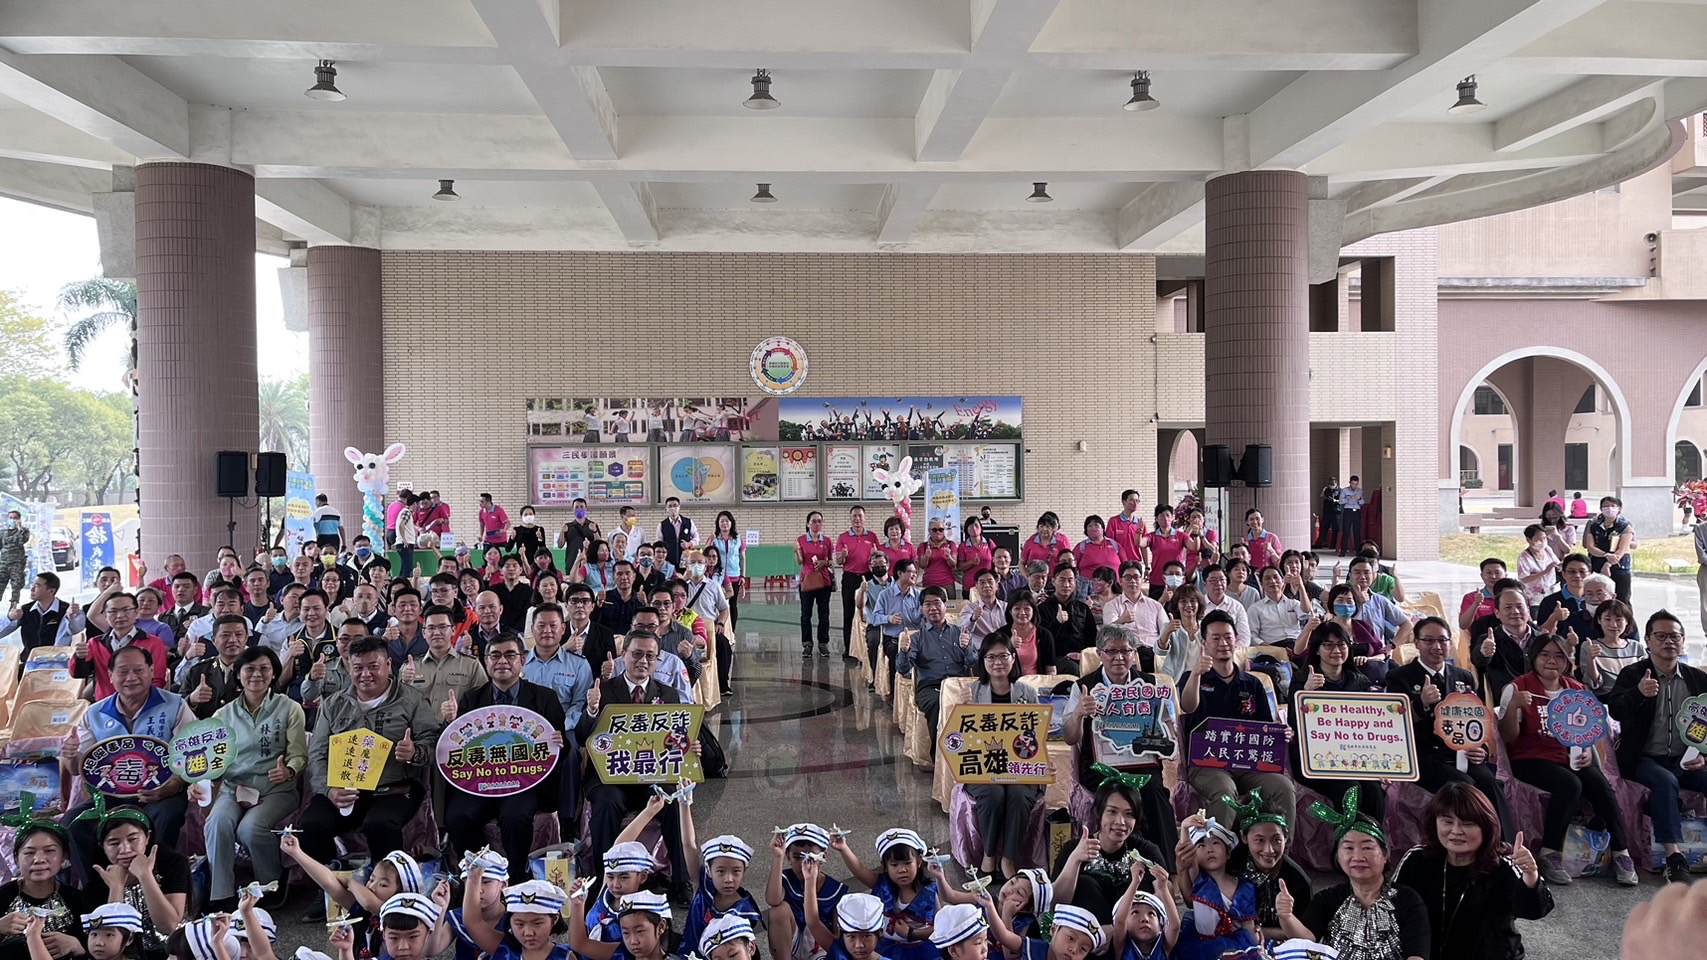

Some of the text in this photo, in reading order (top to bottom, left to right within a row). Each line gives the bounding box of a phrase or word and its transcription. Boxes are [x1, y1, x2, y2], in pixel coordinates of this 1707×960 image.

[953, 399, 999, 417] Energy
[1111, 686, 1171, 700] 全民國防
[1322, 704, 1386, 717] Be Healthy,
[1440, 705, 1485, 718] 健康校園
[609, 710, 691, 734] 反毒反詐
[959, 711, 1040, 733] 反毒反詐
[1317, 717, 1394, 729] Be Happy and
[174, 727, 230, 751] 高雄反毒
[1204, 729, 1276, 747] 踏實作國防
[1311, 731, 1404, 743] Say No to Drugs.
[83, 738, 135, 771] 拒絕毒品
[187, 754, 207, 774] 雄
[210, 742, 228, 770] 安全
[446, 742, 551, 767] 反毒無國界
[606, 749, 684, 776] 我最行
[957, 749, 1009, 776] 高雄
[1203, 746, 1275, 763] 人民不驚慌
[114, 758, 145, 786] 毒
[452, 763, 547, 781] Say No to Drugs.
[1007, 761, 1048, 776] 領先行
